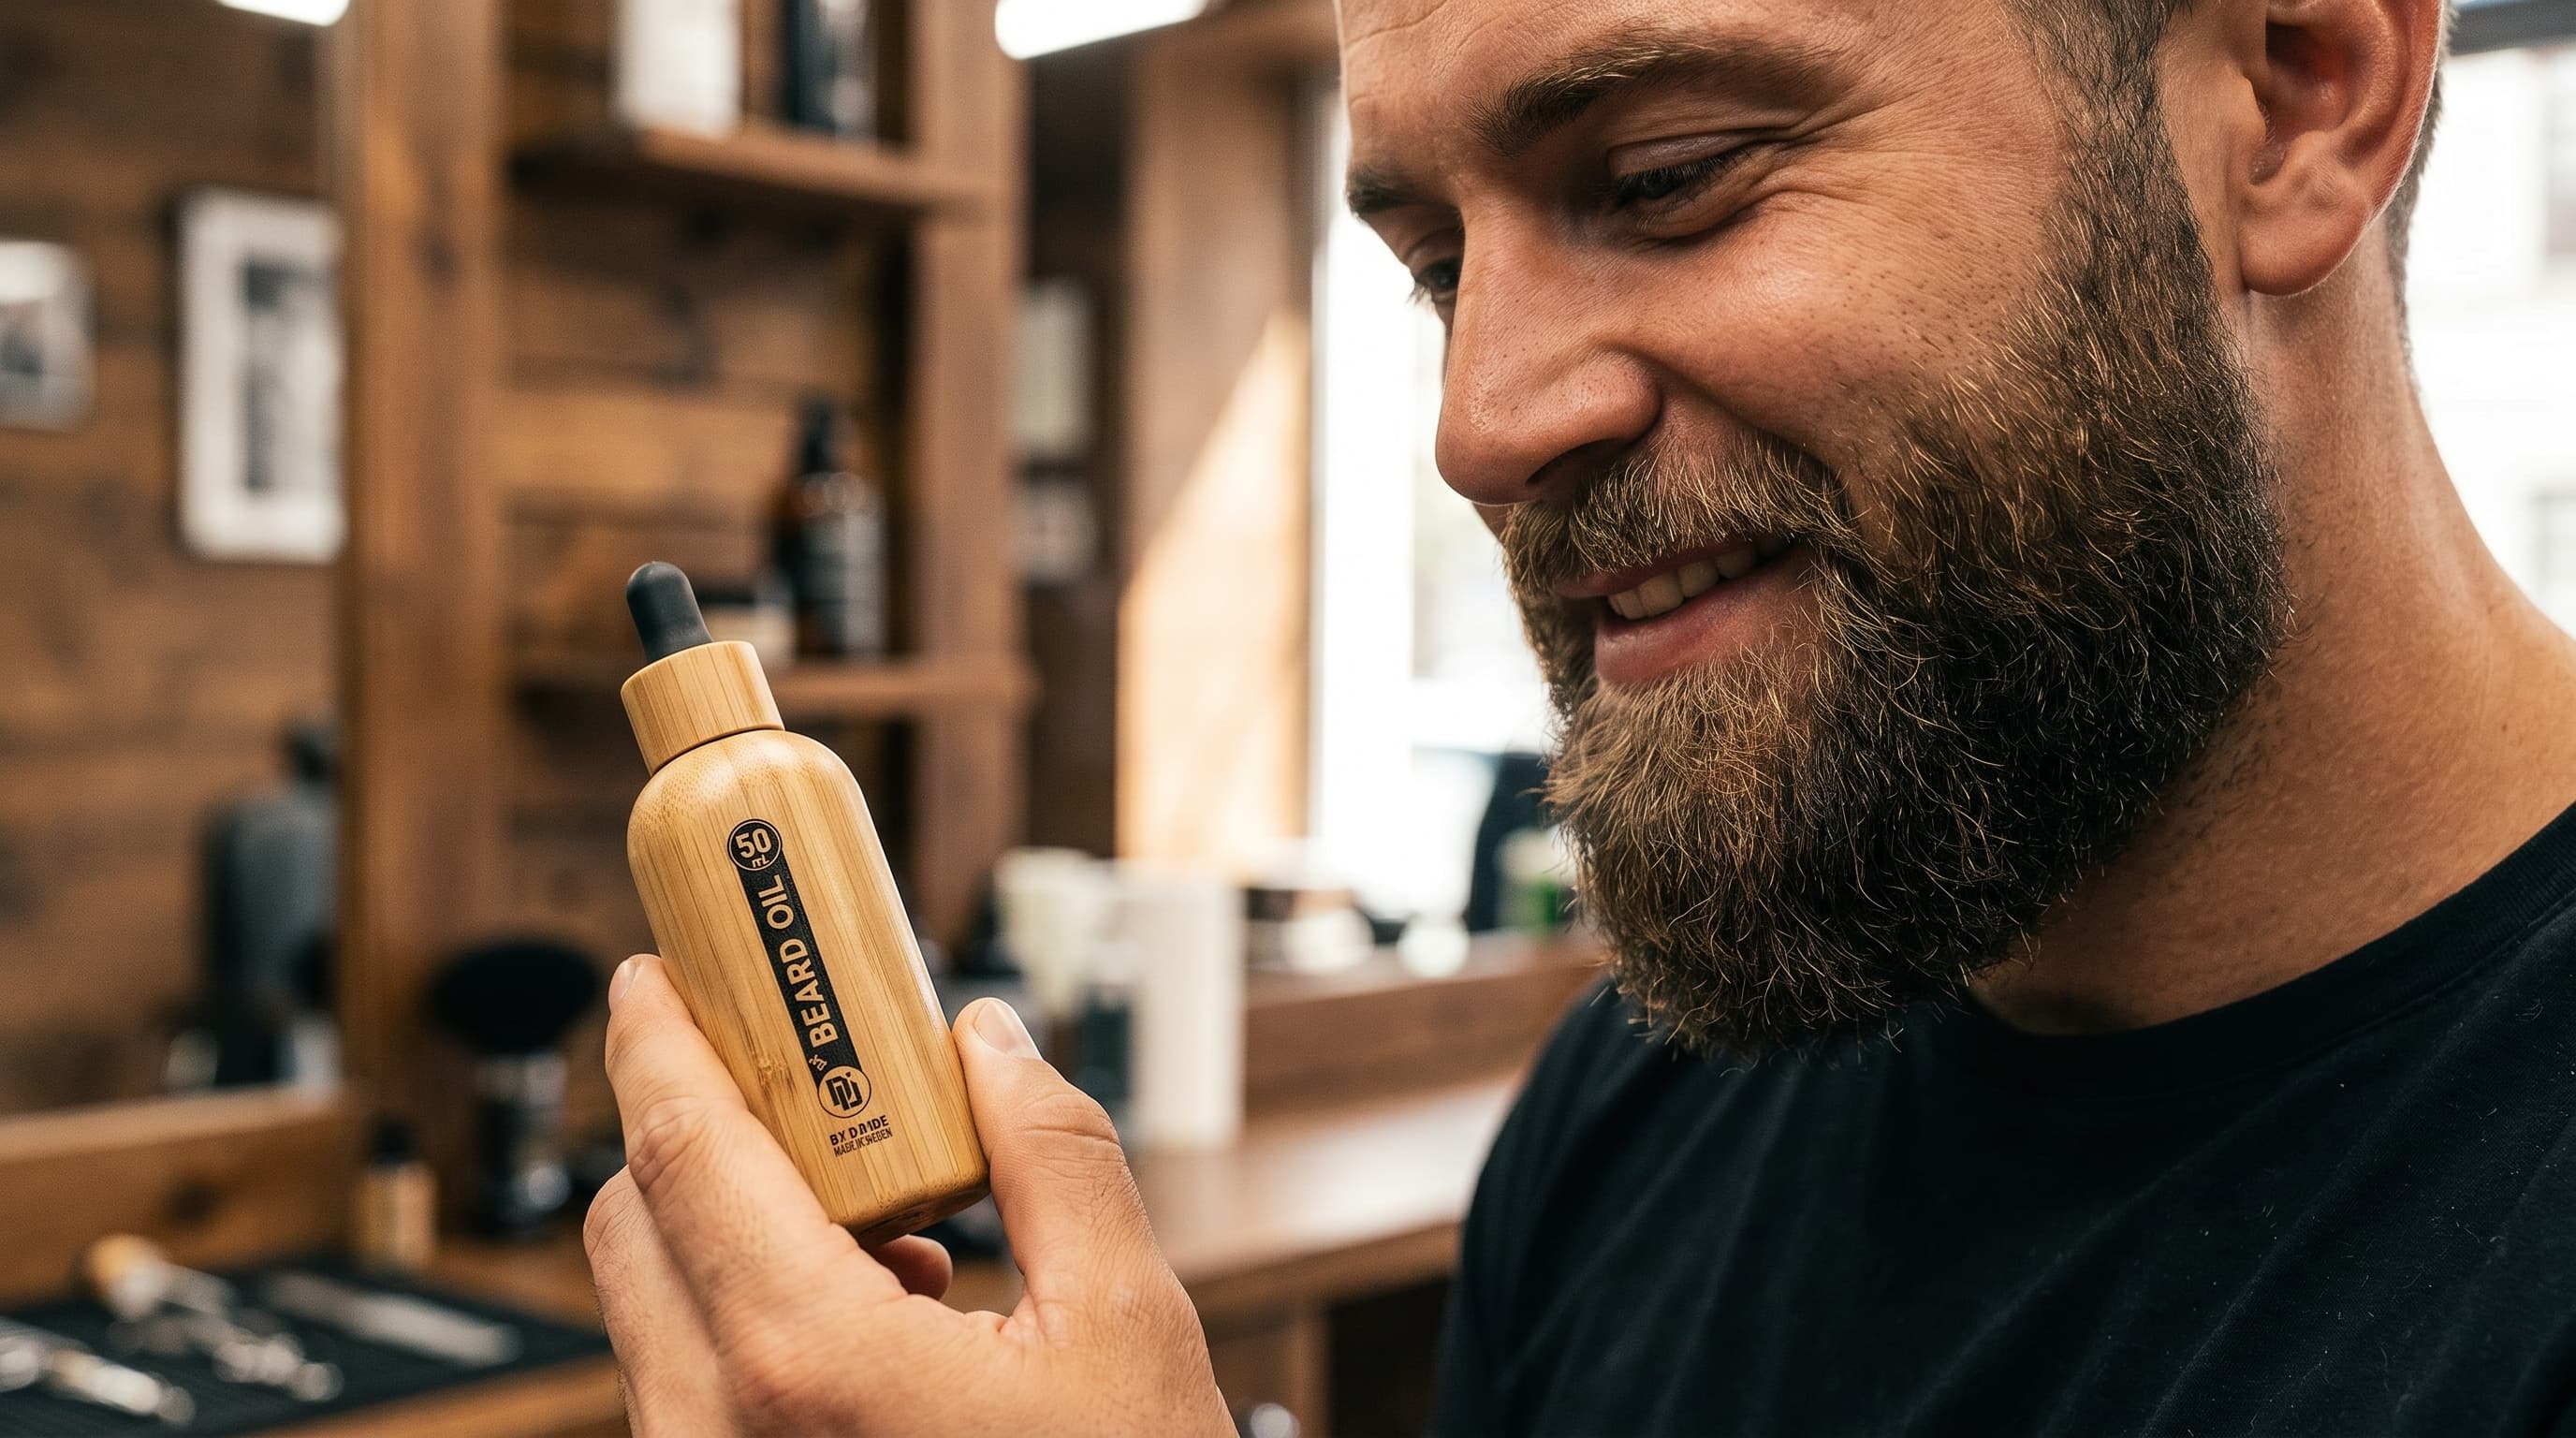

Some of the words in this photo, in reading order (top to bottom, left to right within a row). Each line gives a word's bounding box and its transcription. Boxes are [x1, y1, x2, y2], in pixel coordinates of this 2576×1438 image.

[735, 828, 772, 859] 50
[758, 873, 795, 930] OIL
[780, 938, 839, 1049] BEARD
